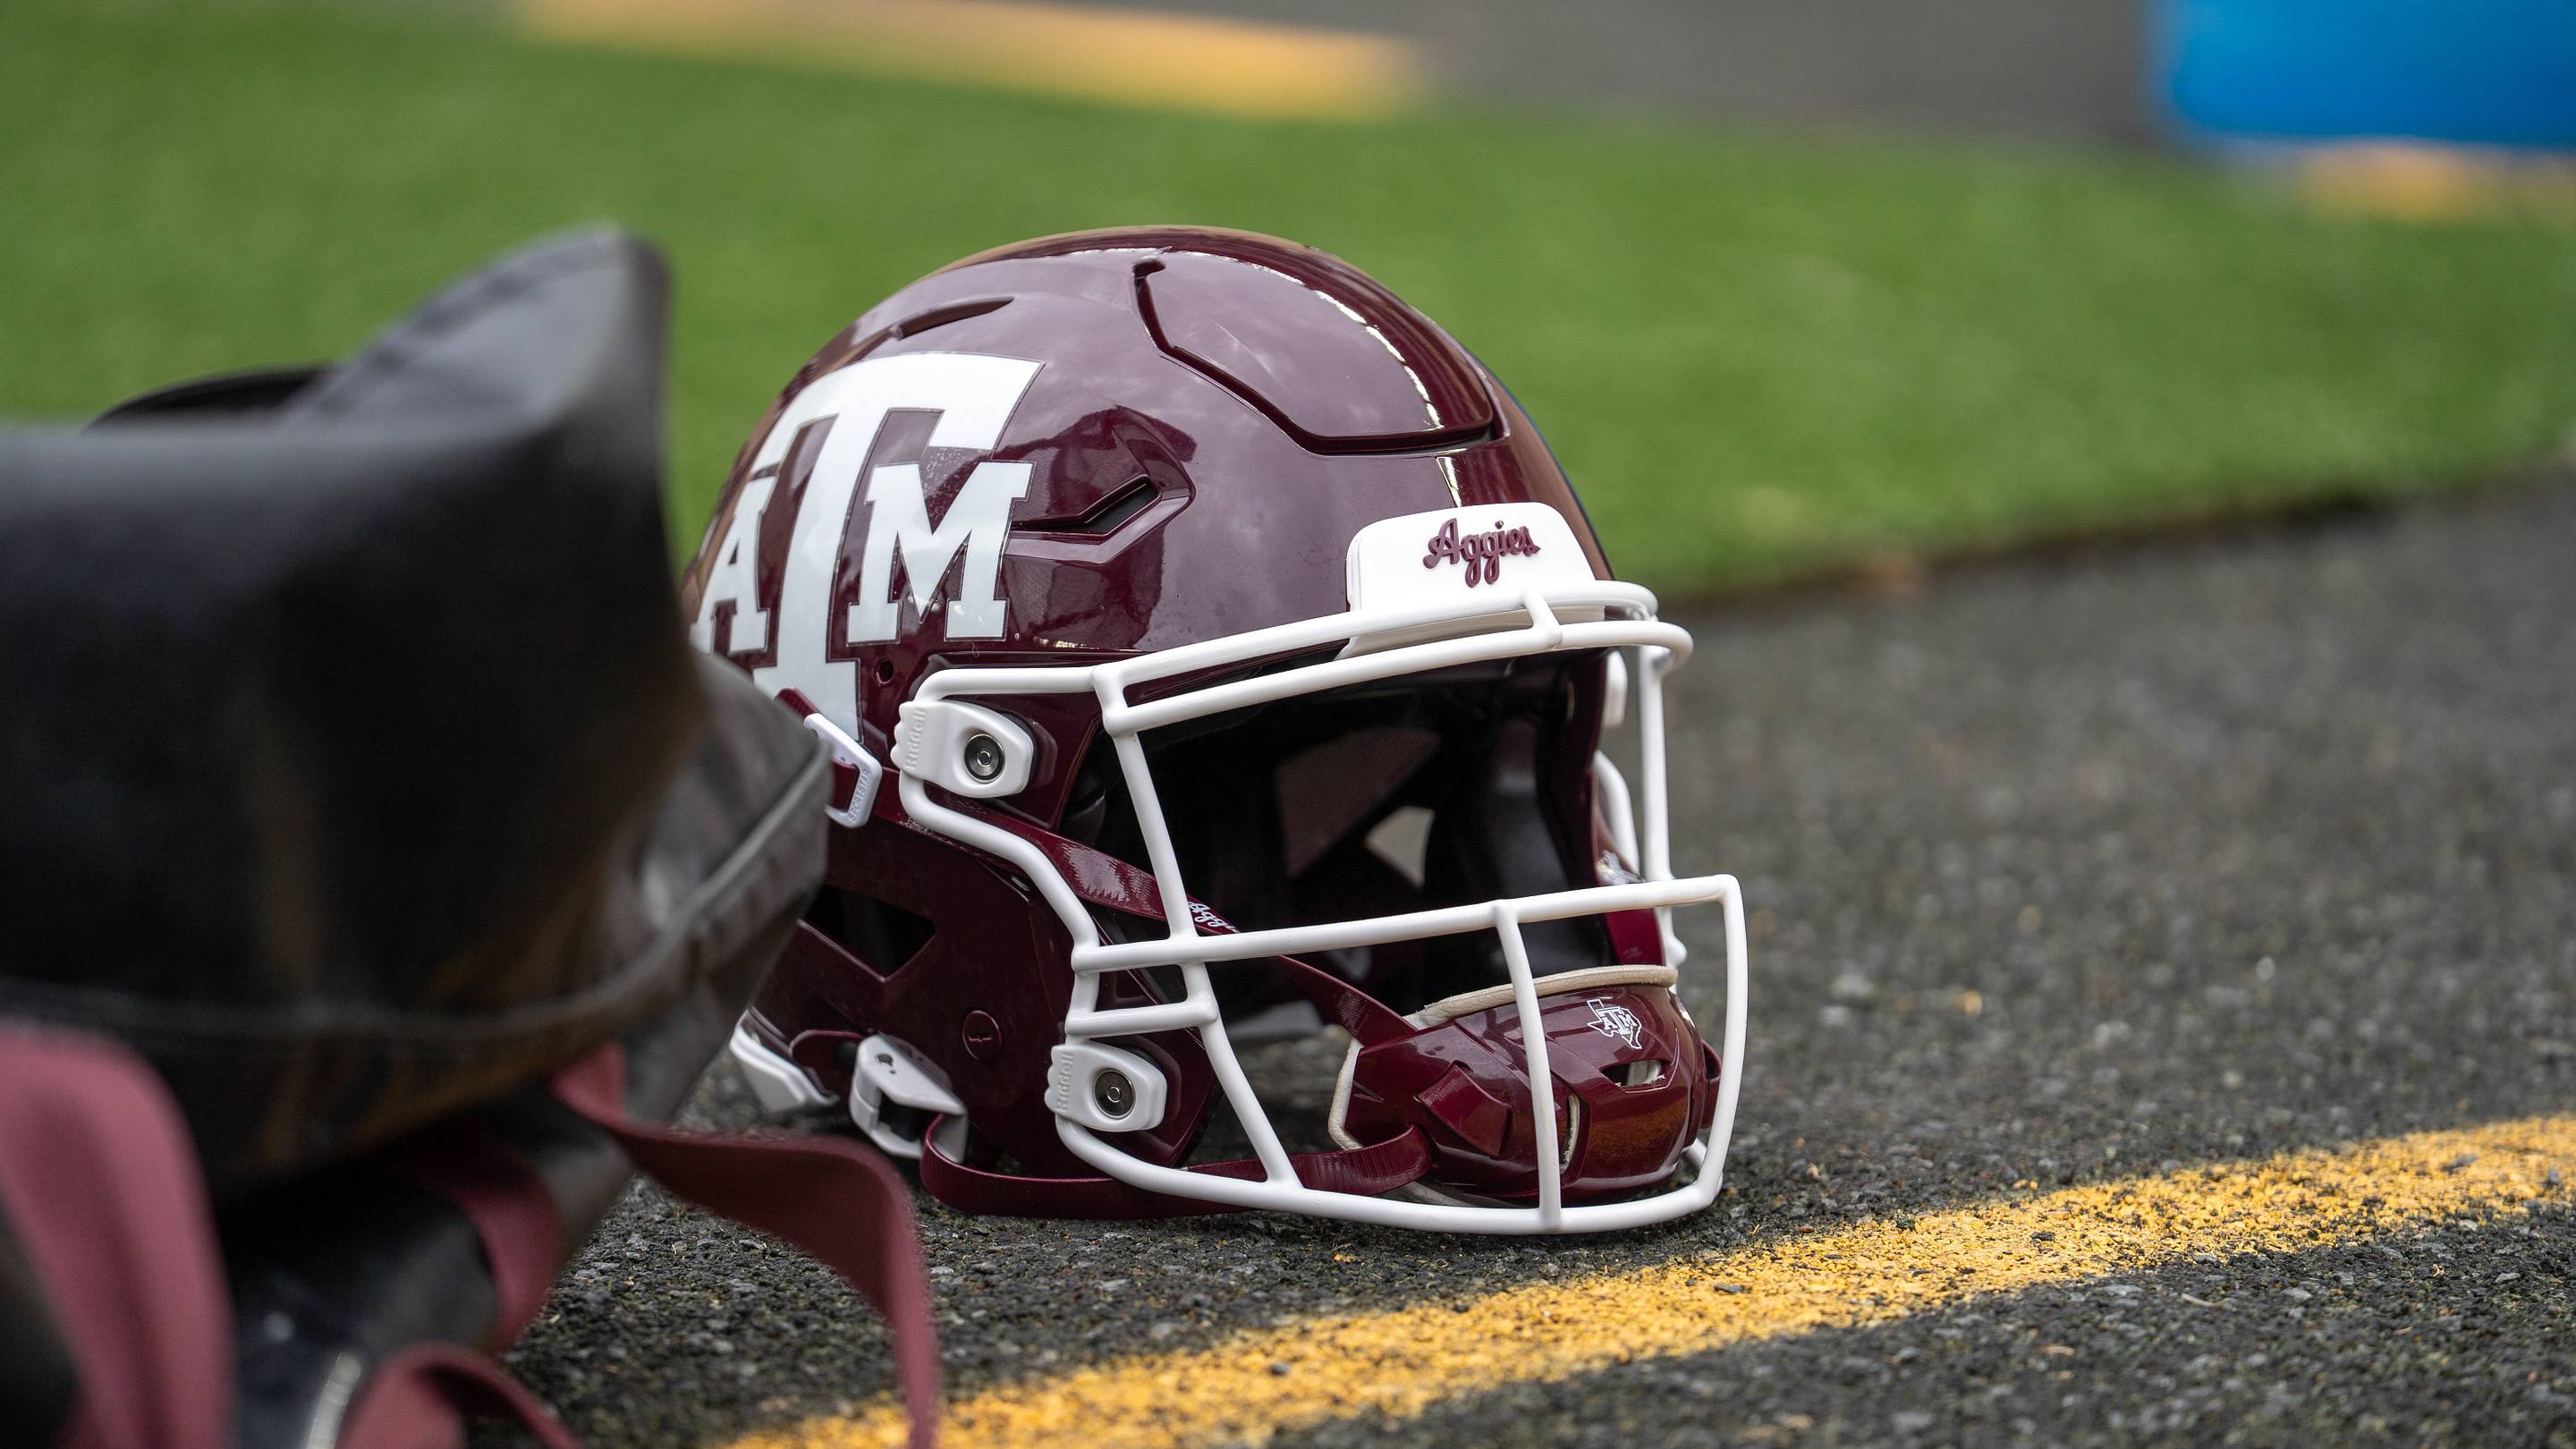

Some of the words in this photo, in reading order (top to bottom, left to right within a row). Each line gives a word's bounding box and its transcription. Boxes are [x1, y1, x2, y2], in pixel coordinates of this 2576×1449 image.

[1423, 518, 1541, 588] Aggies
[906, 708, 928, 769] Riddell
[1055, 1052, 1074, 1114] Riddell
